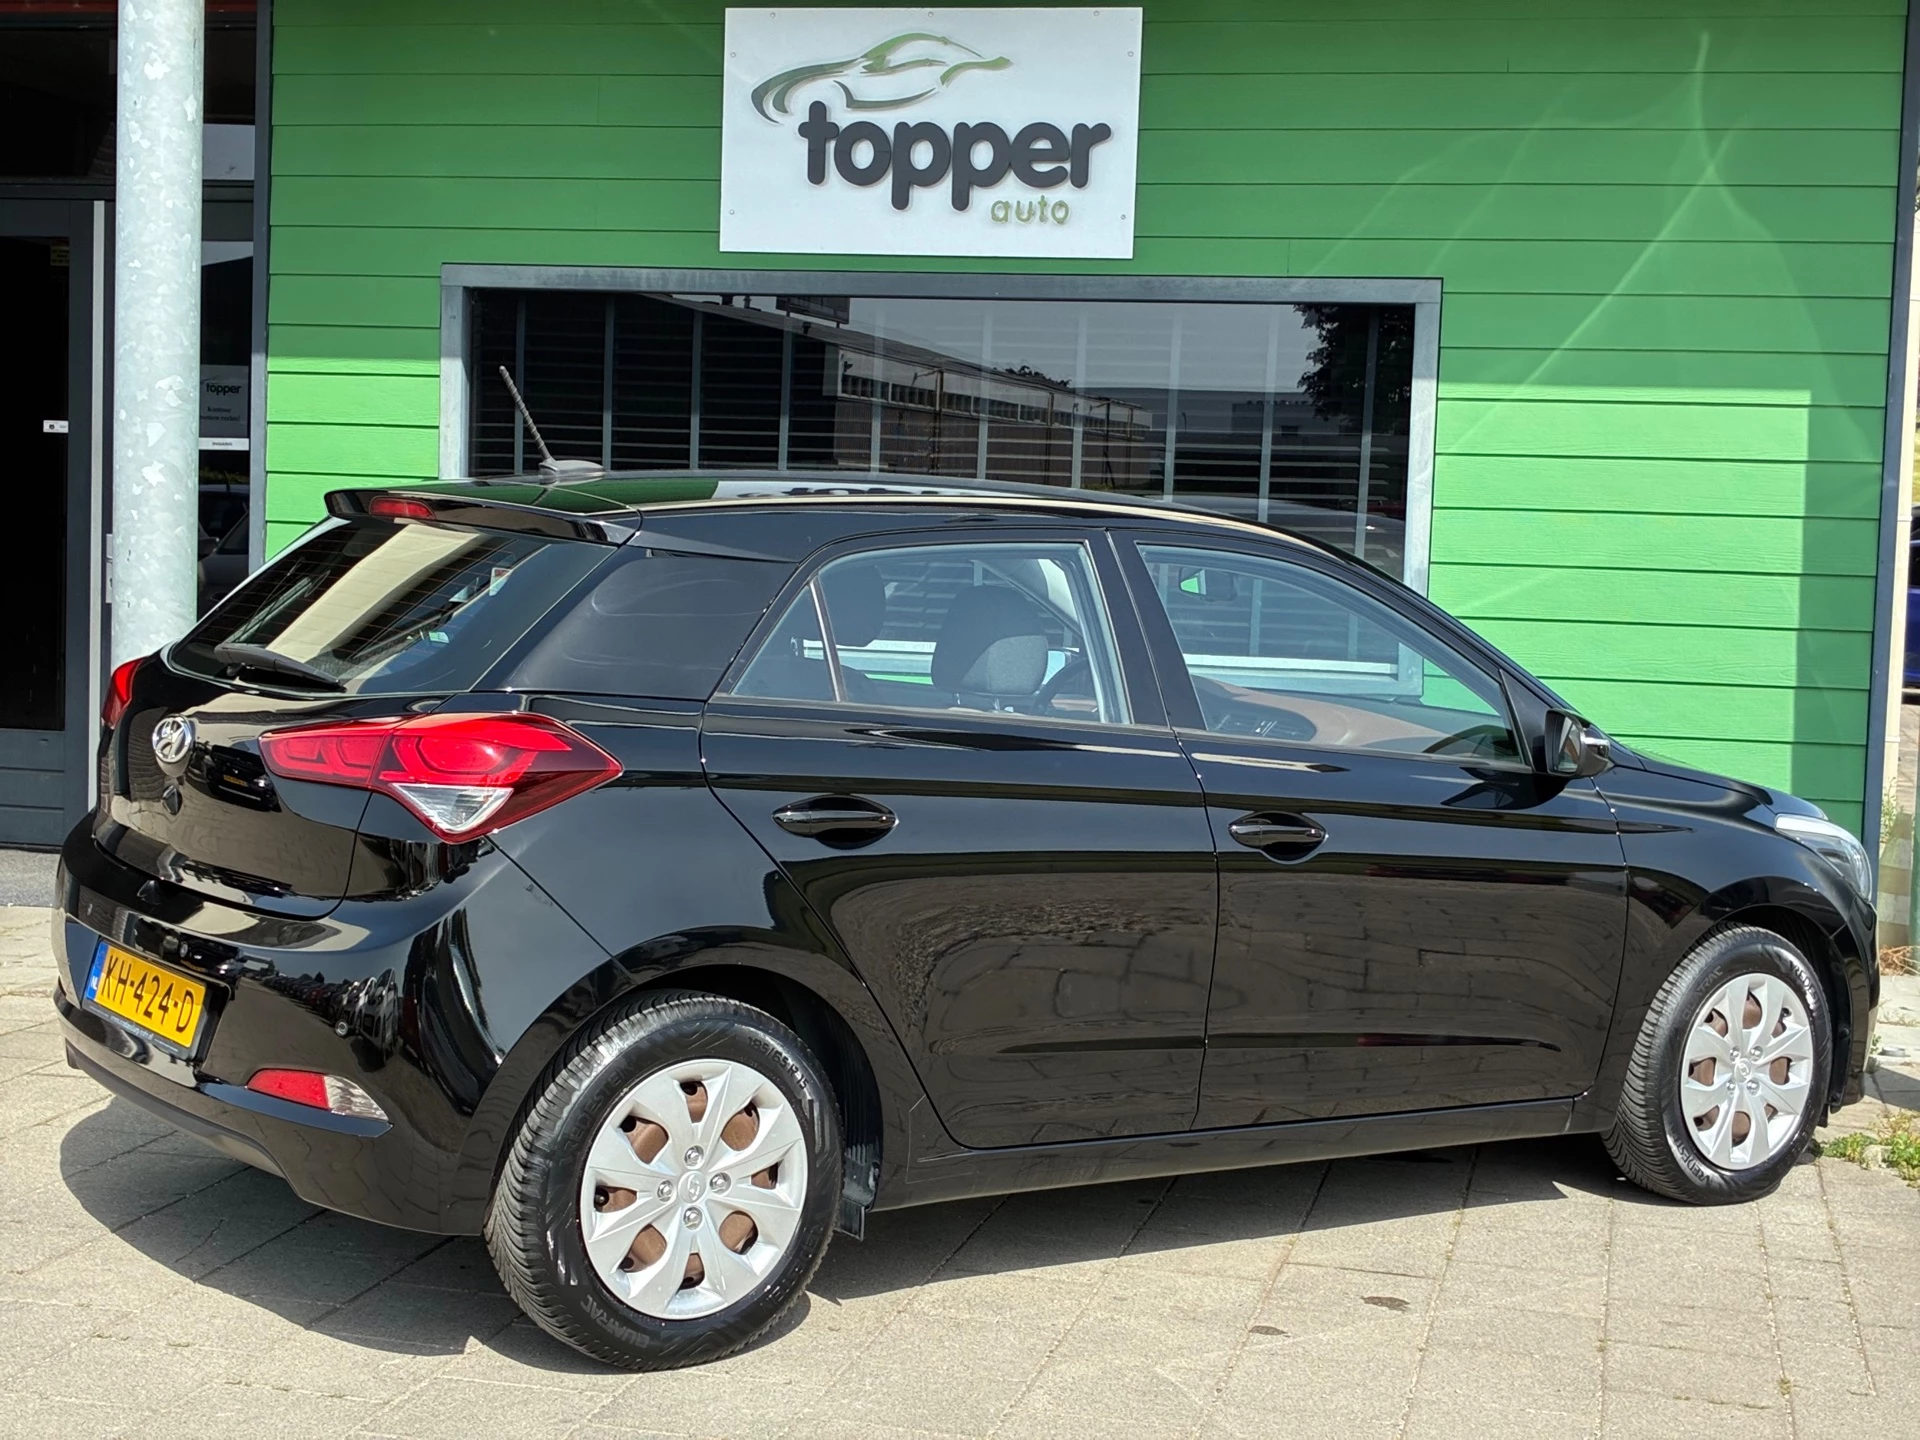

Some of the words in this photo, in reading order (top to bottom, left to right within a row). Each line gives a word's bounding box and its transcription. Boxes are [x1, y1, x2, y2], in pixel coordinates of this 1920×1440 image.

[798, 100, 1112, 211] topper
[990, 195, 1070, 224] auto
[206, 383, 241, 396] topper
[101, 954, 195, 1034] KH-424-D
